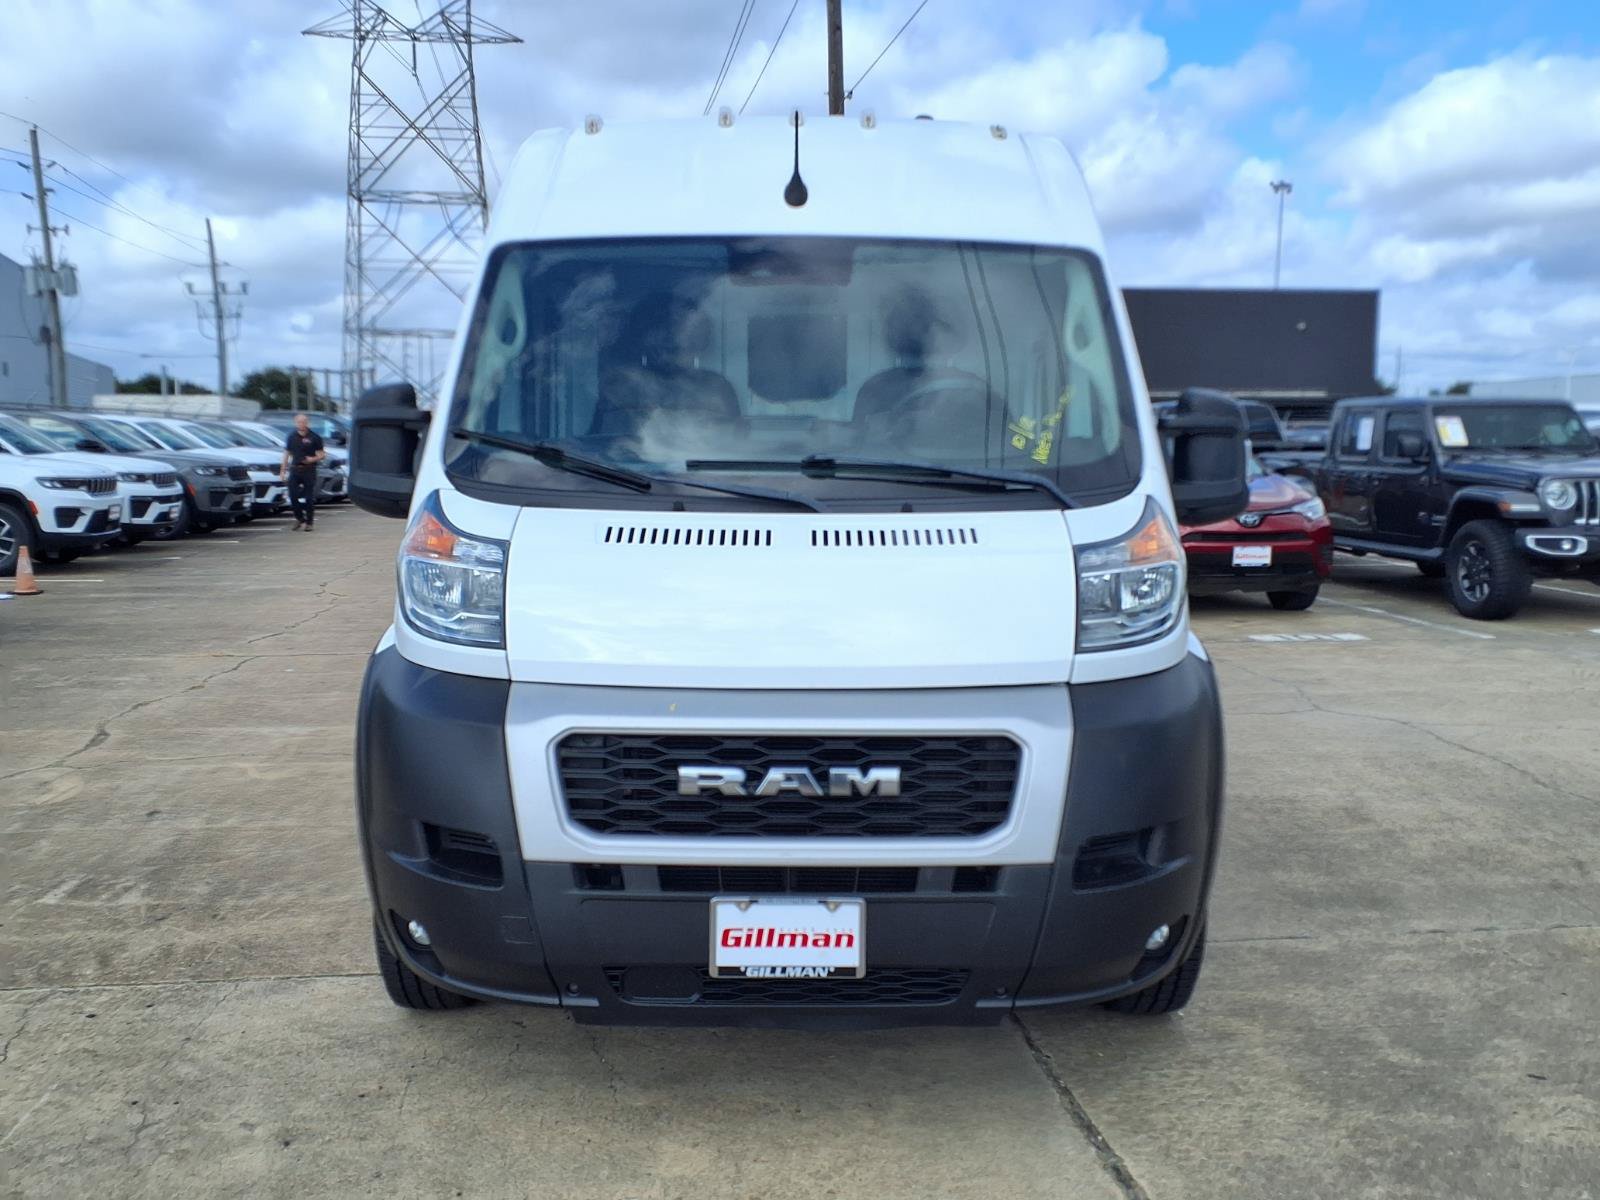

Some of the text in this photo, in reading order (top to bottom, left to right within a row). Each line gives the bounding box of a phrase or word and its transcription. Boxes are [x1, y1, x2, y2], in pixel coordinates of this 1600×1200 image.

[677, 766, 901, 796] RAM
[721, 928, 854, 948] Gillman
[745, 967, 829, 978] GILLMAN
